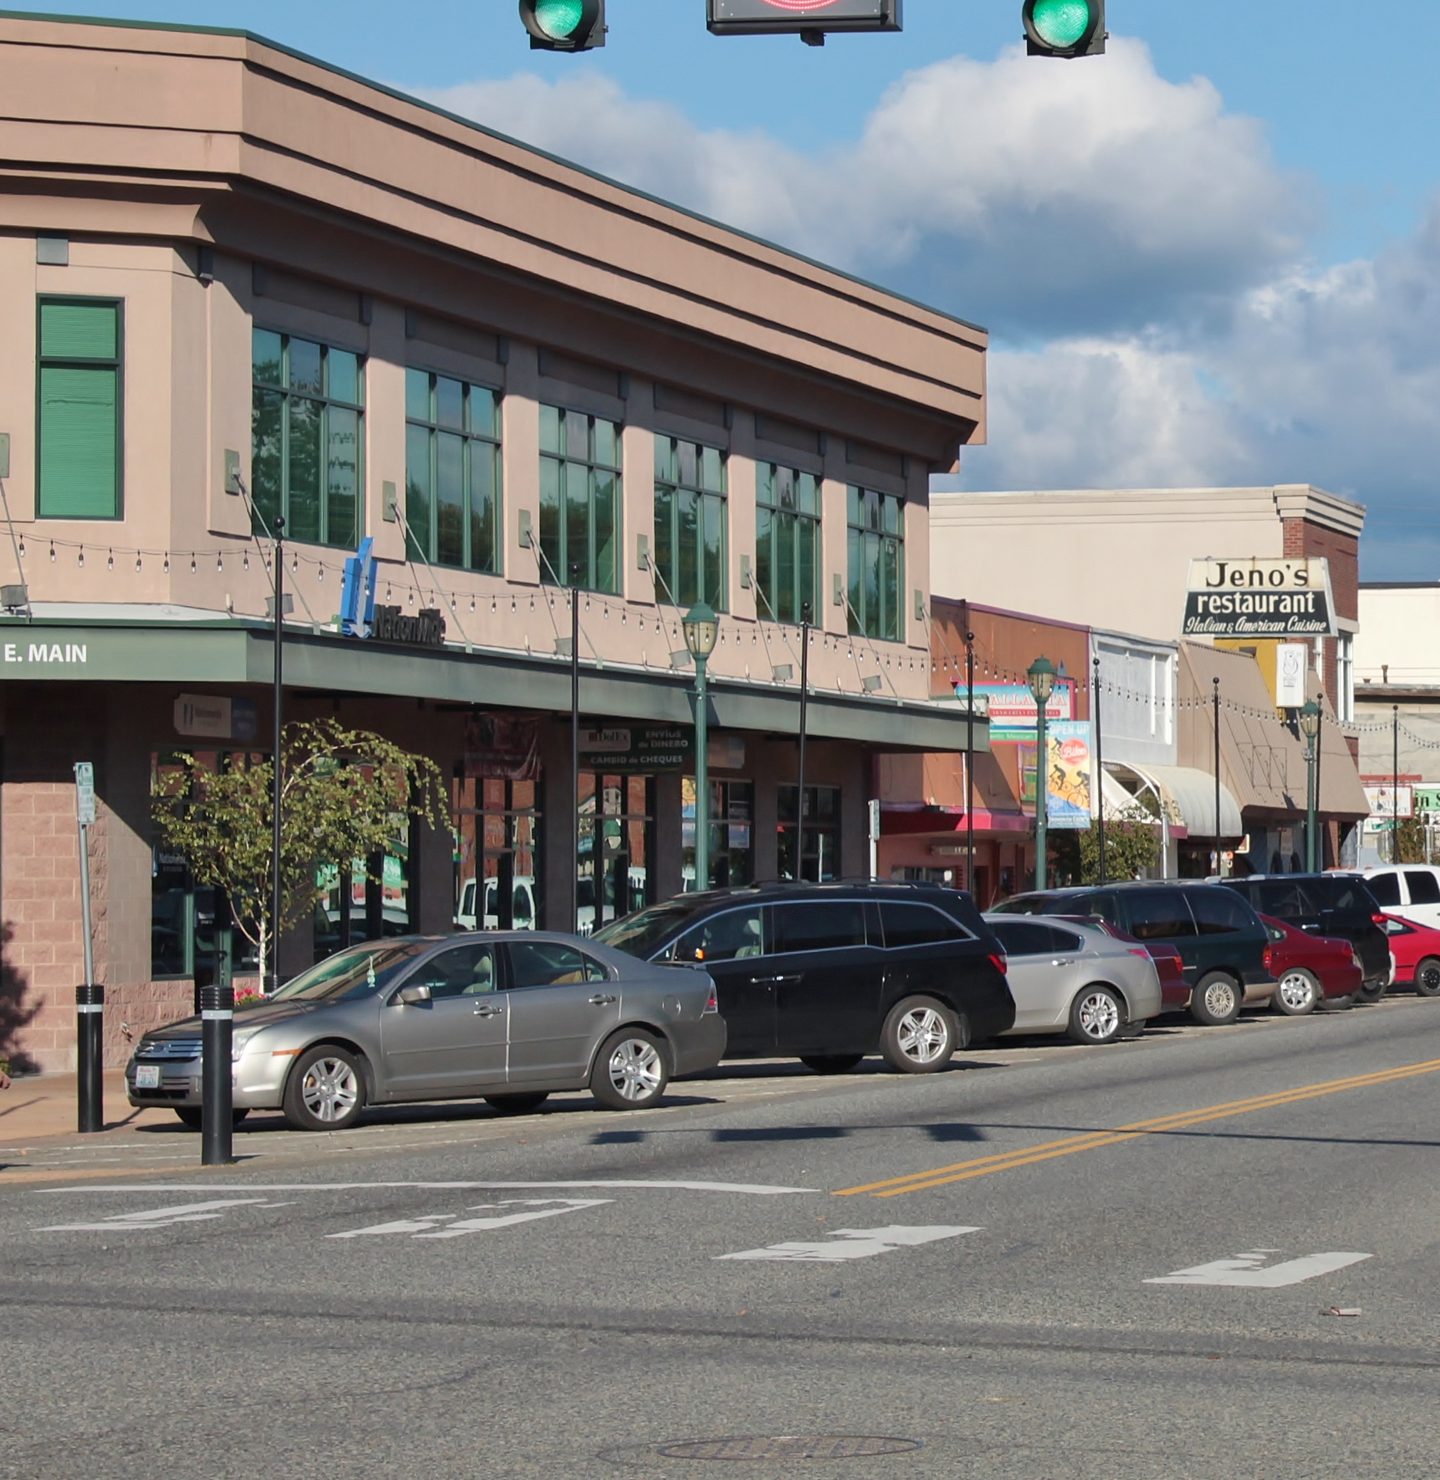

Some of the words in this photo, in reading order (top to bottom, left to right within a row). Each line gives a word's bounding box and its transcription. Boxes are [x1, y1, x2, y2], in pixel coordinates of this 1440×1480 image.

[1206, 562, 1309, 587] Jeno's
[1197, 592, 1316, 614] restaurant
[1185, 616, 1227, 633] Italian
[1226, 621, 1234, 634] &
[1235, 616, 1285, 633] American
[1287, 615, 1327, 632] Cuisine
[5, 644, 23, 662] E.
[28, 644, 87, 663] MAIN
[640, 755, 683, 764] CHEQUES
